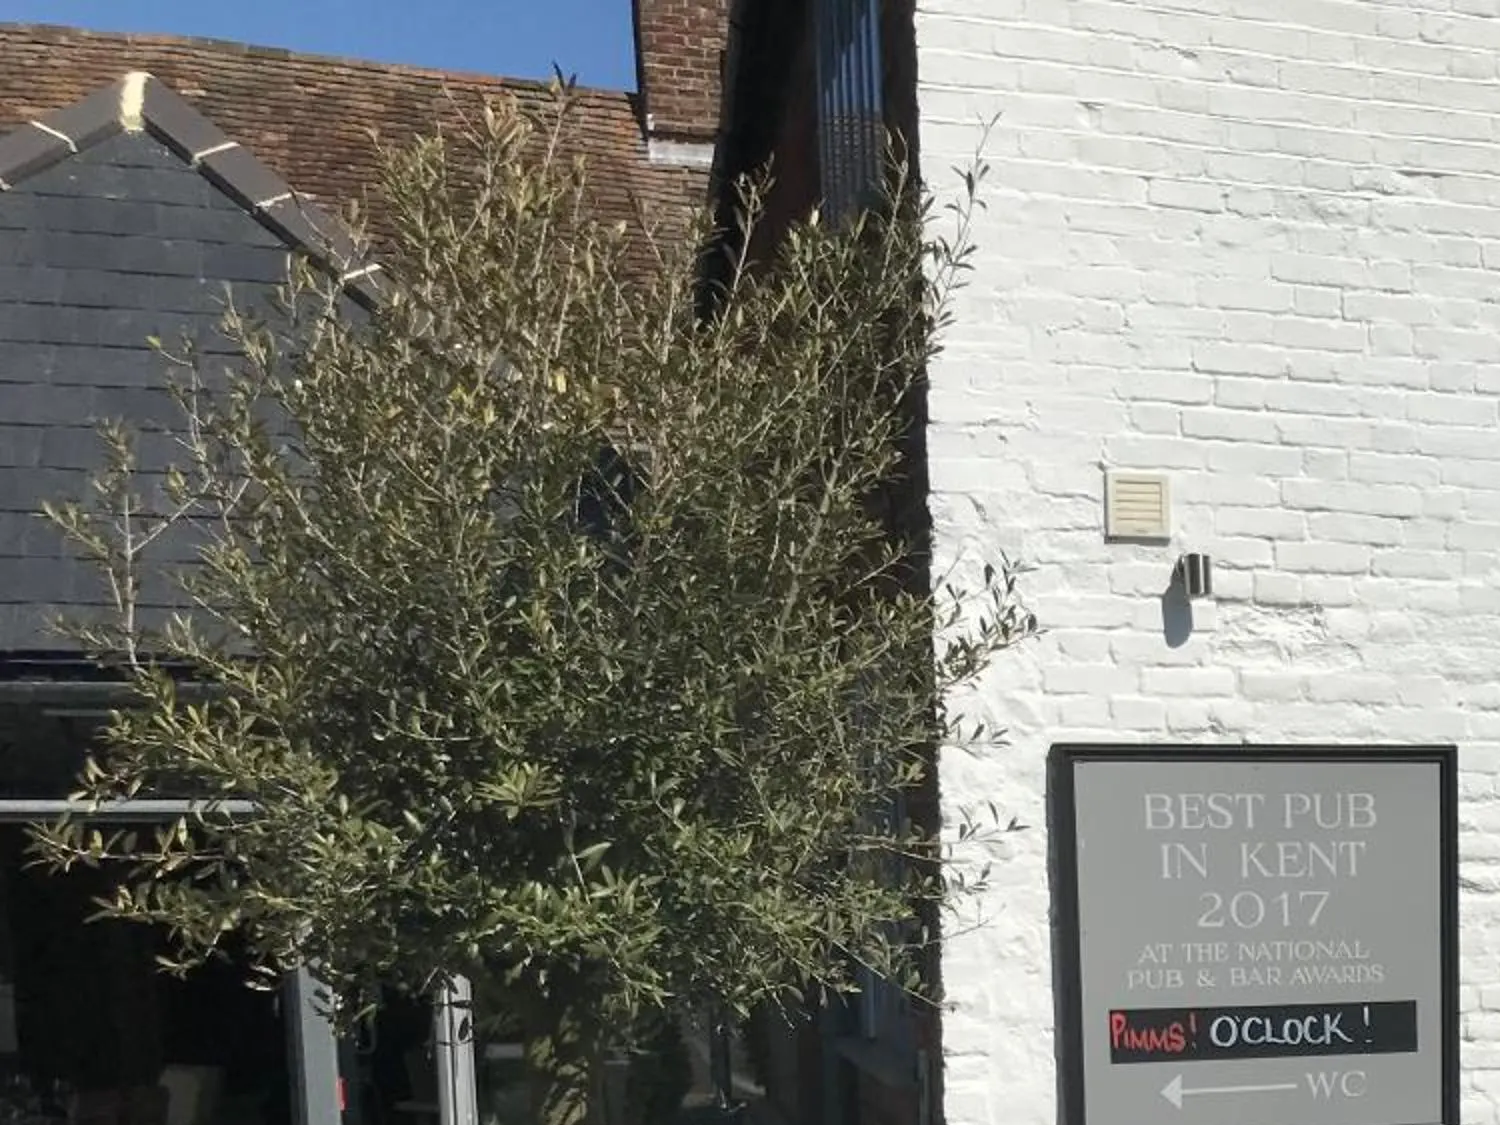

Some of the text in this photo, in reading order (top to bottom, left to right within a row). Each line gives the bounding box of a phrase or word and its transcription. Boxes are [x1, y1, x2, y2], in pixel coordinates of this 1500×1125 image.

[1144, 792, 1377, 830] BEST PUB
[1160, 841, 1367, 879] IN KENT
[1196, 890, 1330, 929] 2017
[1138, 940, 1371, 964] AT THE NATIONAL
[1127, 964, 1385, 990] PUB & BAR AWARDS
[1305, 1071, 1367, 1099] WC
